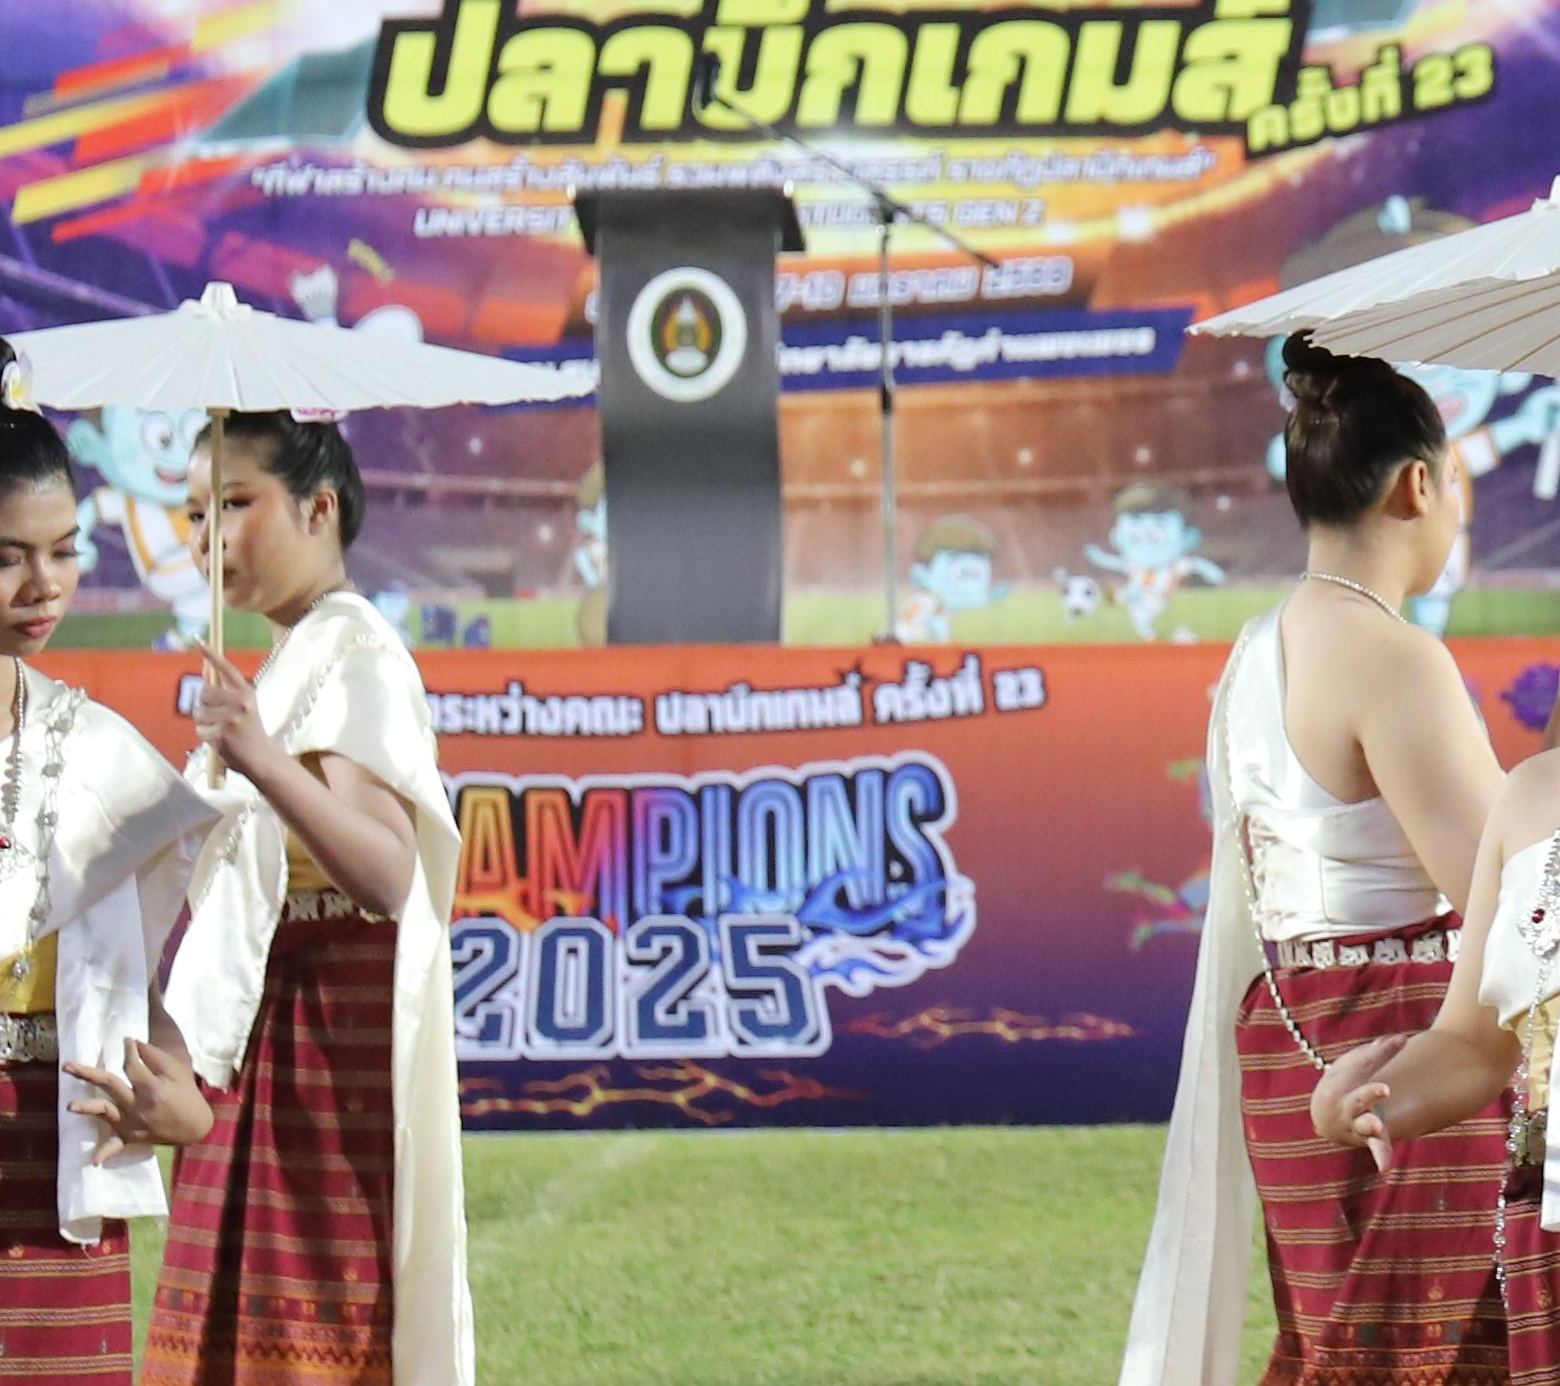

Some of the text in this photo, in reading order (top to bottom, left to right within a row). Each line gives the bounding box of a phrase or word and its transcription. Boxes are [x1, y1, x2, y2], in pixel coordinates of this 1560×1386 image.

[1246, 41, 1496, 156] ครั้งที่ 23
[454, 762, 948, 937] AMPIONS
[452, 916, 826, 1051] 2025
